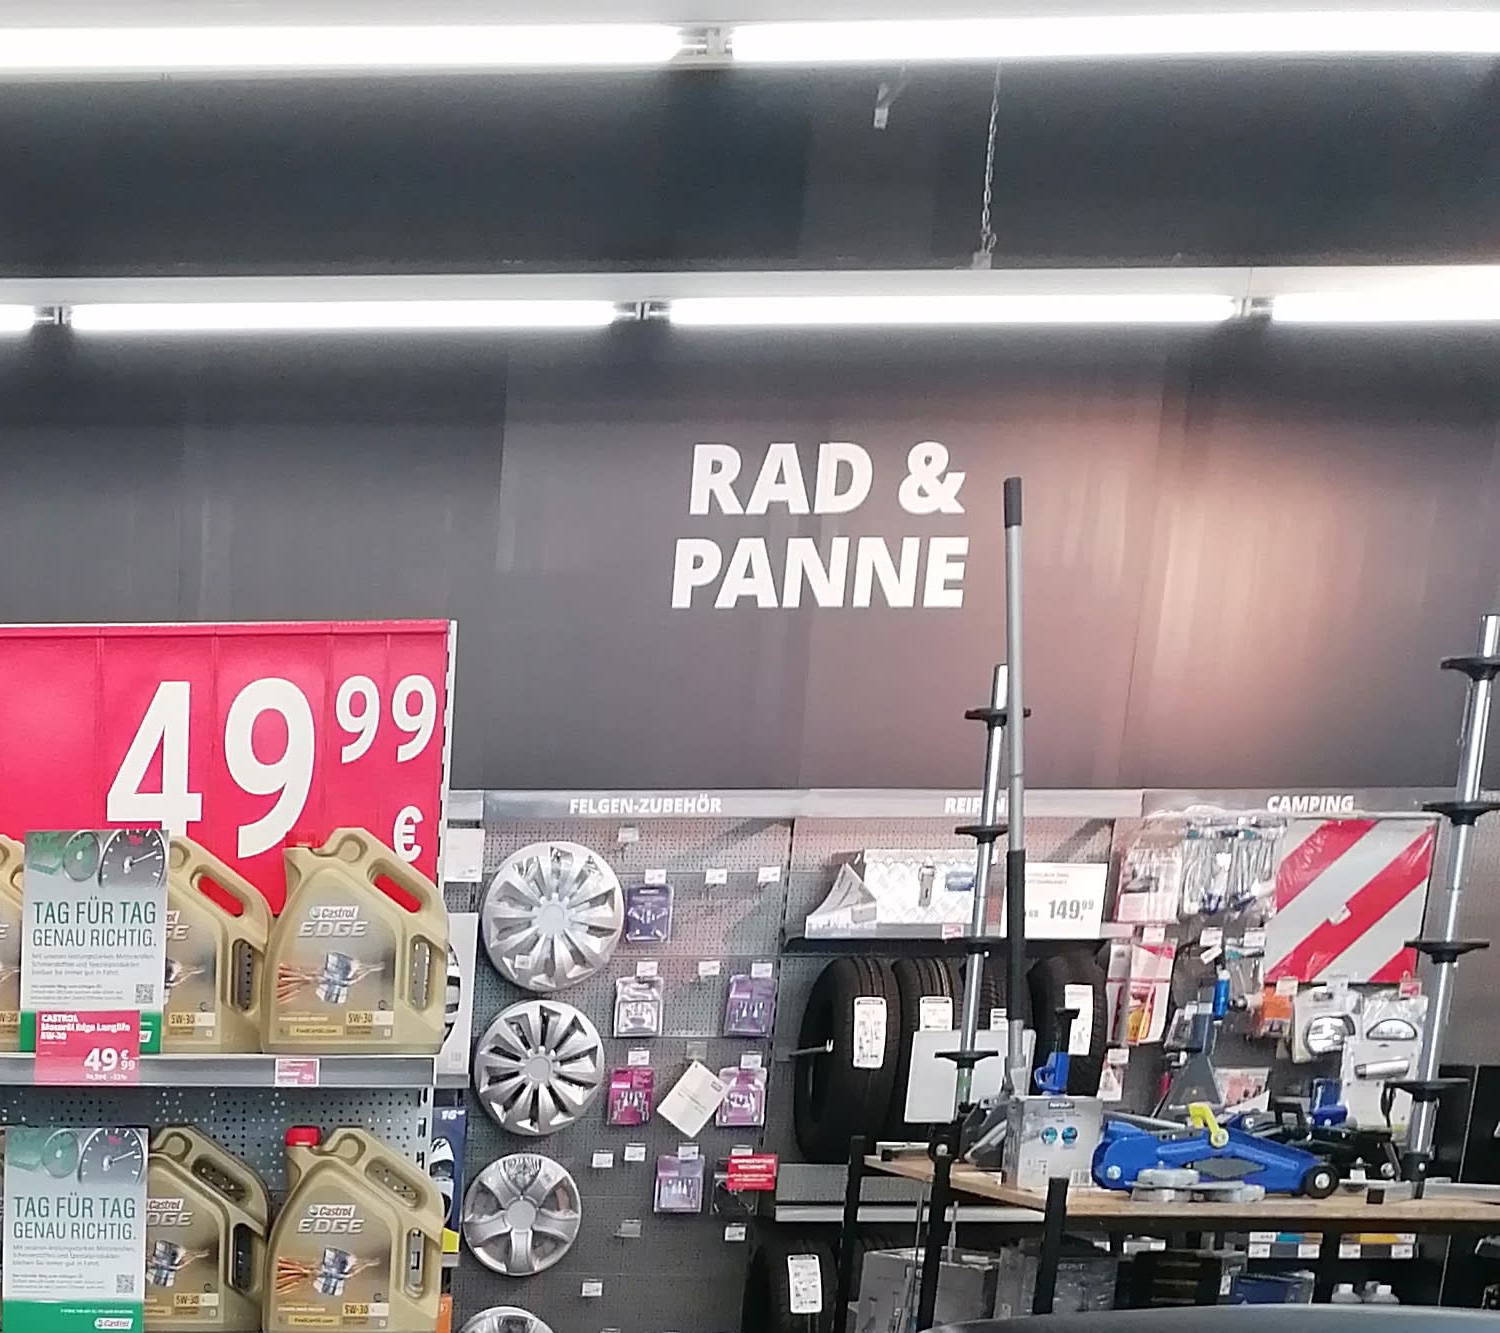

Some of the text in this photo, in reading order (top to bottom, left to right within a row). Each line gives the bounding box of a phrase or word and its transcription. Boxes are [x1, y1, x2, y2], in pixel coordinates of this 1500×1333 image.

[690, 441, 965, 515] RAD &
[671, 536, 969, 608] PANNE
[106, 677, 317, 859] 49
[569, 793, 722, 814] FELGEN-ZUBEHÖR
[1267, 795, 1354, 813] CAMPING
[391, 805, 424, 863] €
[33, 896, 156, 924] TAG FÜR TAG
[322, 906, 356, 920] Castrol
[32, 928, 157, 947] GENAU RICHTIG.
[299, 921, 368, 937] EDGE
[41, 1014, 78, 1022] CASTROL
[171, 1013, 195, 1024] 5W-30
[348, 1013, 373, 1024] 5W-30
[83, 1047, 118, 1072] 49
[13, 1192, 136, 1218] TAG FÜR TAG
[319, 1206, 352, 1216] Castrol
[13, 1222, 137, 1240] GENAU RICHTIG.
[297, 1218, 364, 1233] EDGE
[345, 1304, 369, 1314] 5W-30
